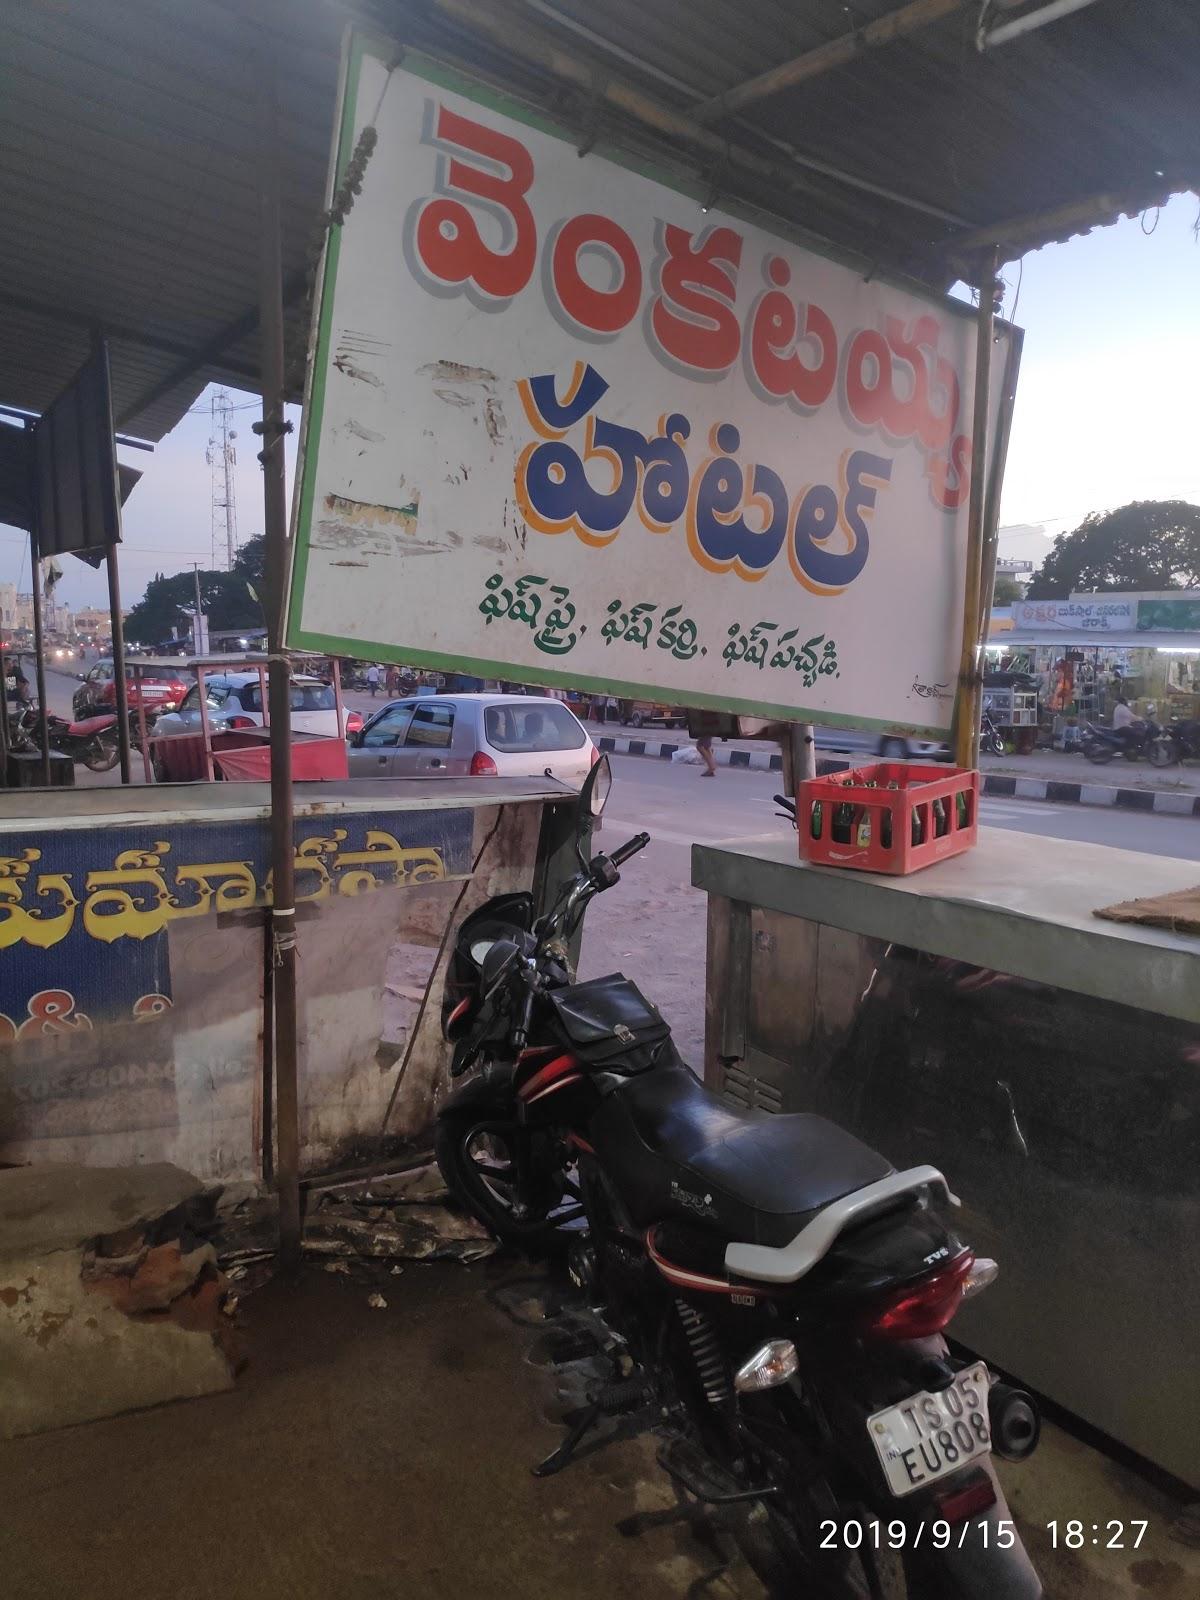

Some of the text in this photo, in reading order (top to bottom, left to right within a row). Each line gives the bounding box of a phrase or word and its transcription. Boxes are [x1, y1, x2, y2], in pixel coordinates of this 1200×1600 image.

[406, 99, 971, 511] వెంకటయ్య
[516, 361, 893, 595] హోటల్
[923, 1246, 949, 1264] TVS
